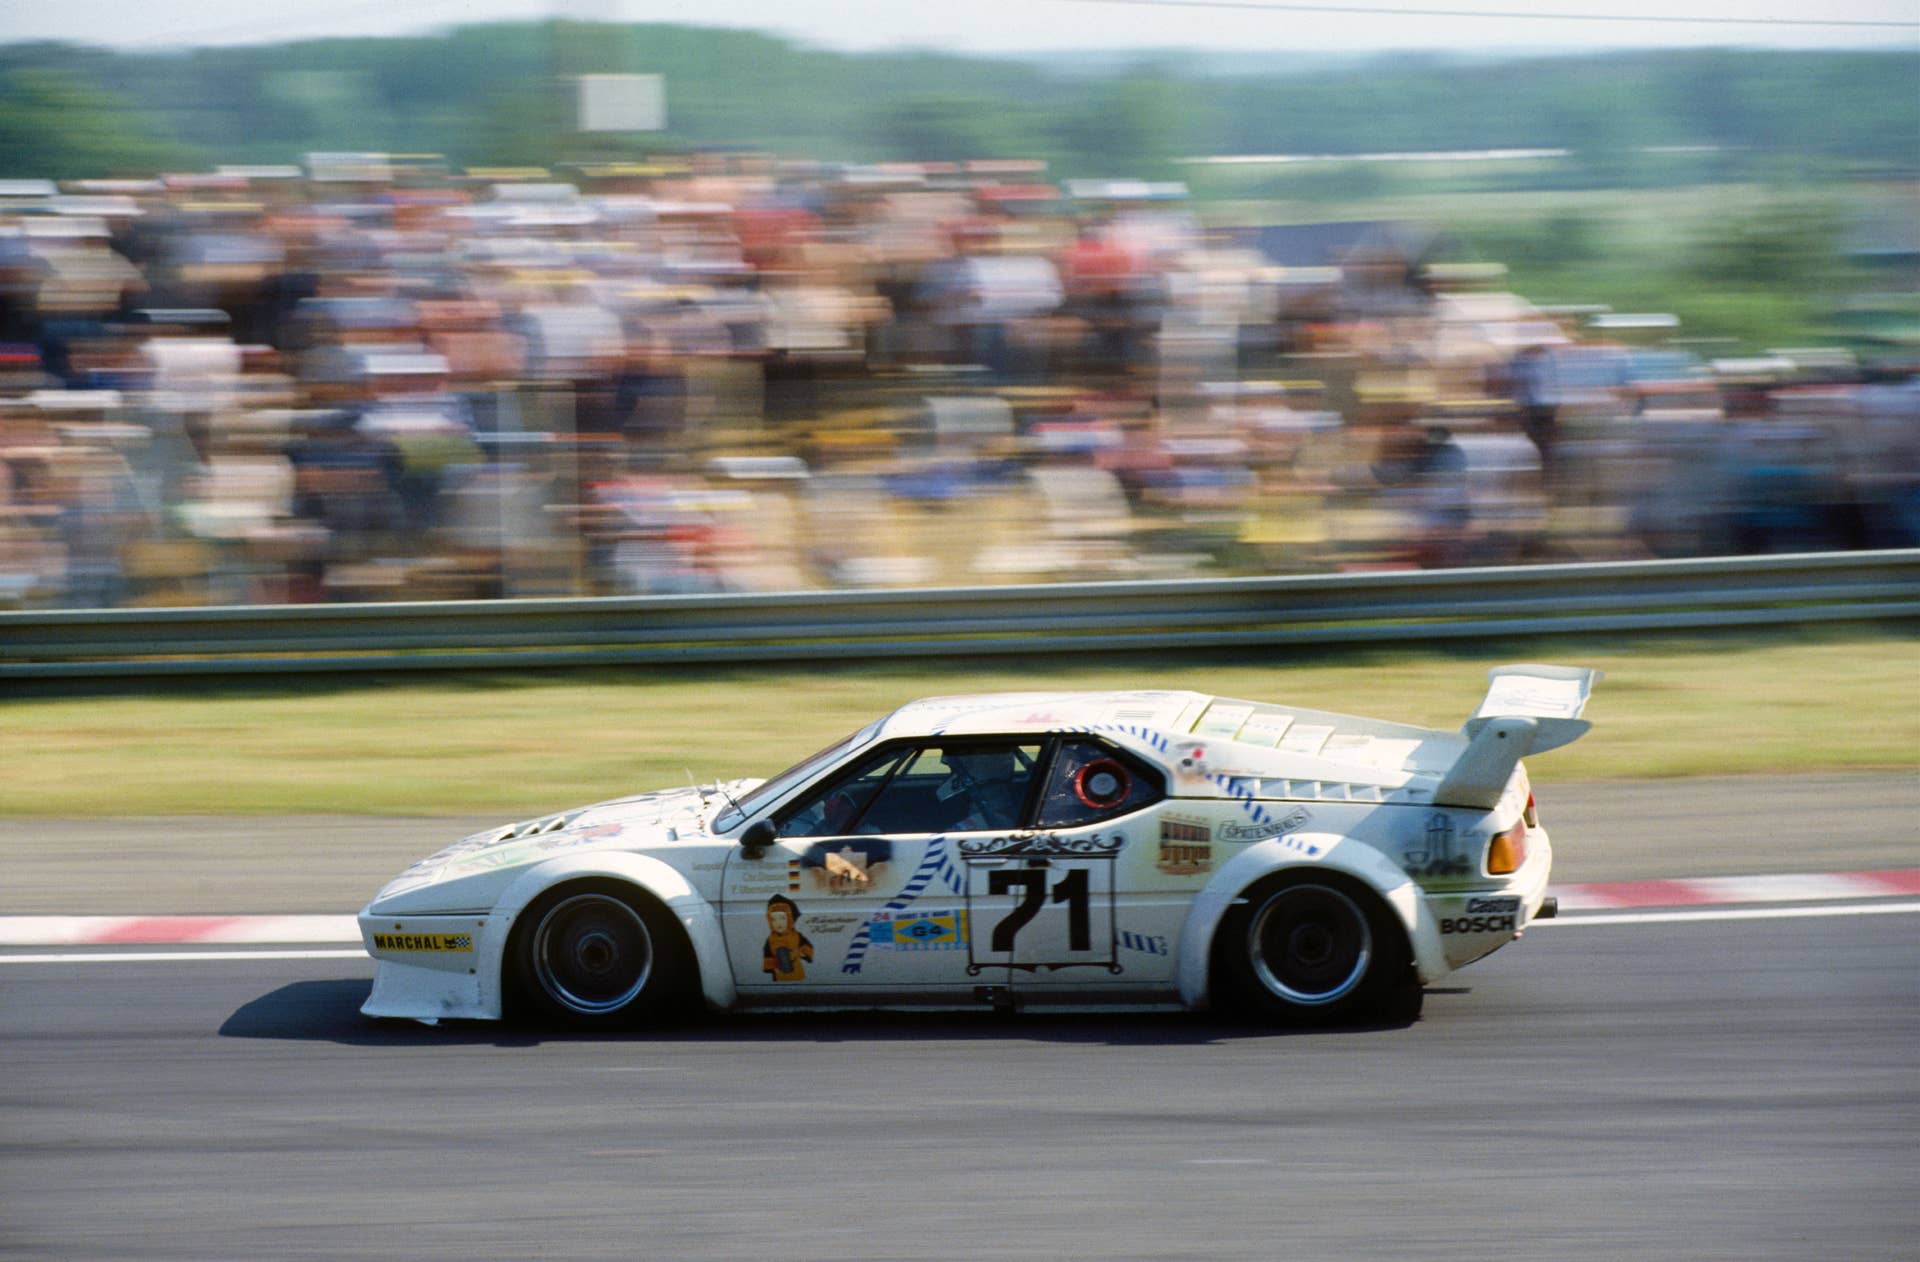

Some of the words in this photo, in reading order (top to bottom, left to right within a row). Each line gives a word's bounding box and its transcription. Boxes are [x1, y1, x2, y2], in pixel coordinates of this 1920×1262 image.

[872, 912, 891, 922] 24
[989, 869, 1091, 952] 71
[911, 925, 942, 937] G4
[1440, 914, 1516, 935] BOSCH
[373, 935, 442, 950] MARCHAL
